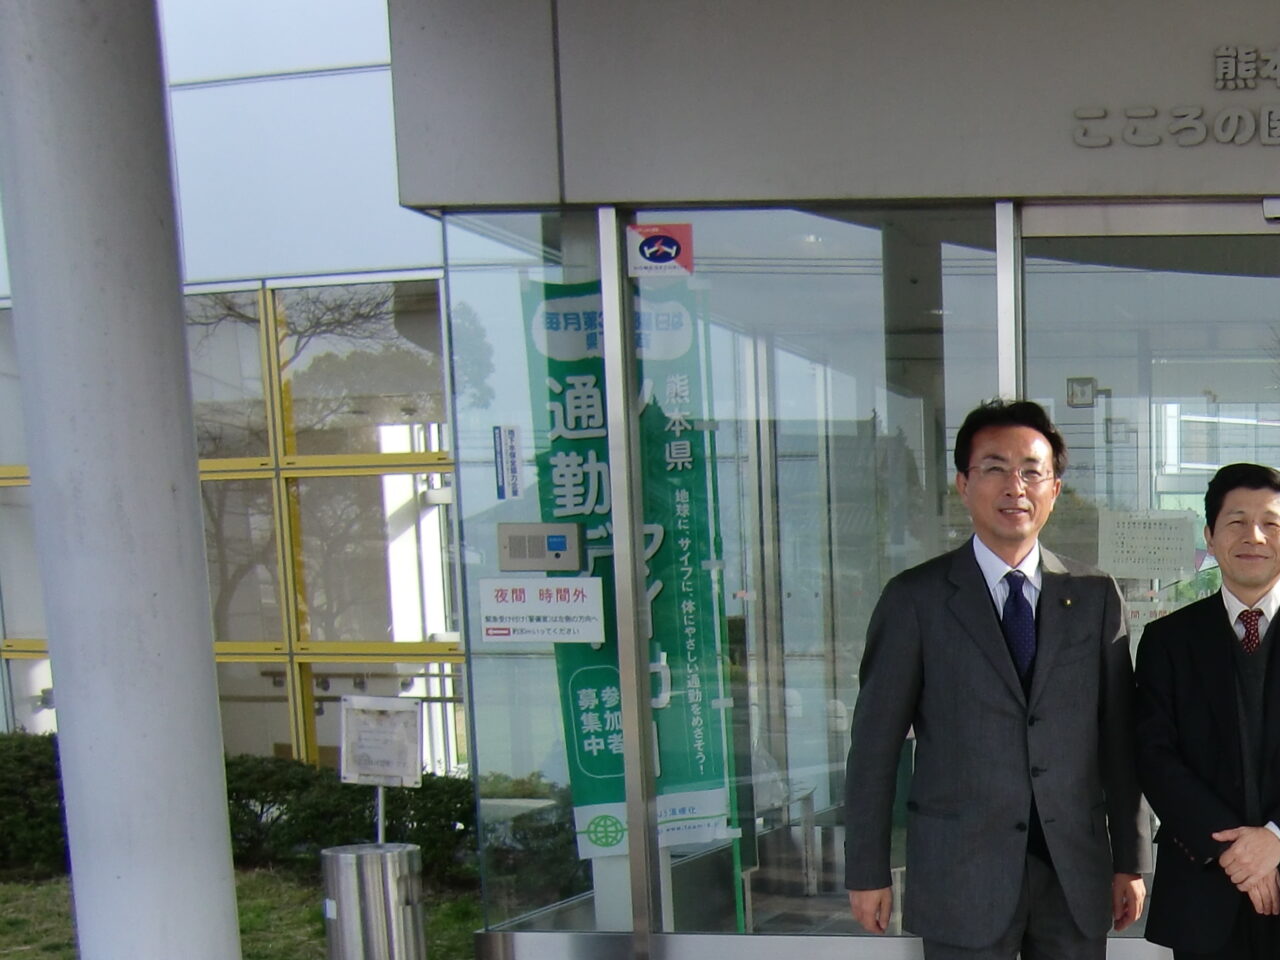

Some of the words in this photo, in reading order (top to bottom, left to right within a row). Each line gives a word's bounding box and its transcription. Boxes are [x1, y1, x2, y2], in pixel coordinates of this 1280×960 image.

[665, 374, 693, 471] 熊本県
[494, 588, 526, 604] 夜間
[539, 587, 587, 604] 時間外
[577, 688, 605, 756] 募集中
[601, 686, 626, 754] 参加者
